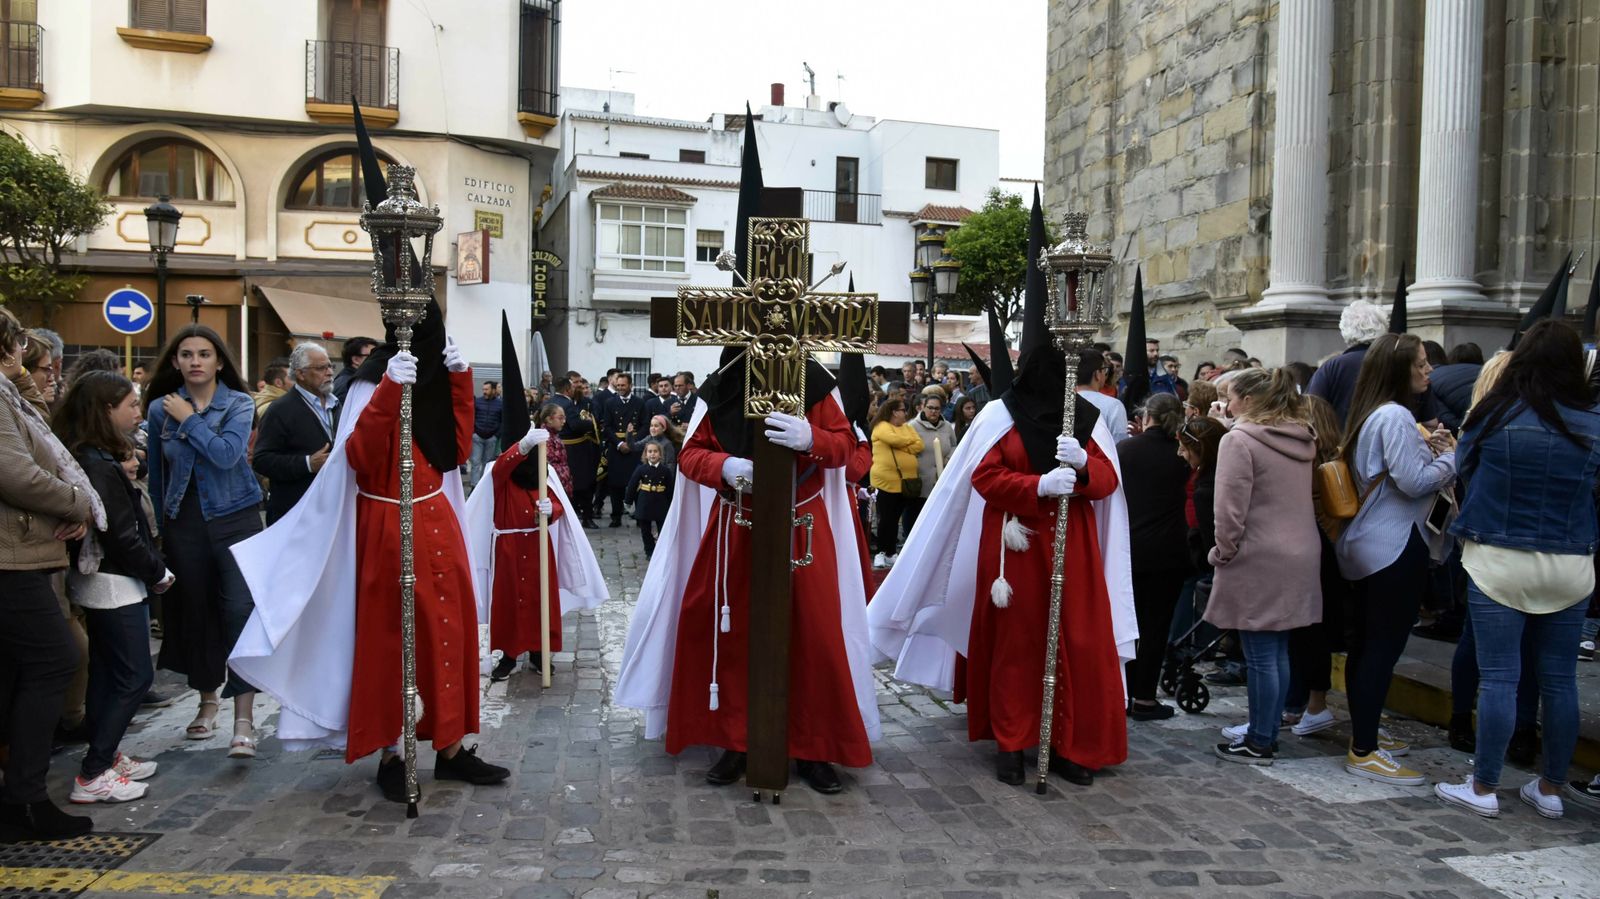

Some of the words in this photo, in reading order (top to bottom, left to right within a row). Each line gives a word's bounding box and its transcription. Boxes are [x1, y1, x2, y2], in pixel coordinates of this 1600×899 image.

[464, 177, 514, 193] EDIFICIO
[467, 193, 511, 207] CALZADA
[755, 243, 802, 280] EGO
[534, 265, 546, 317] HOSTAL
[682, 298, 762, 335] SALUS
[790, 301, 872, 341] VESTRA
[751, 357, 801, 393] SUM
